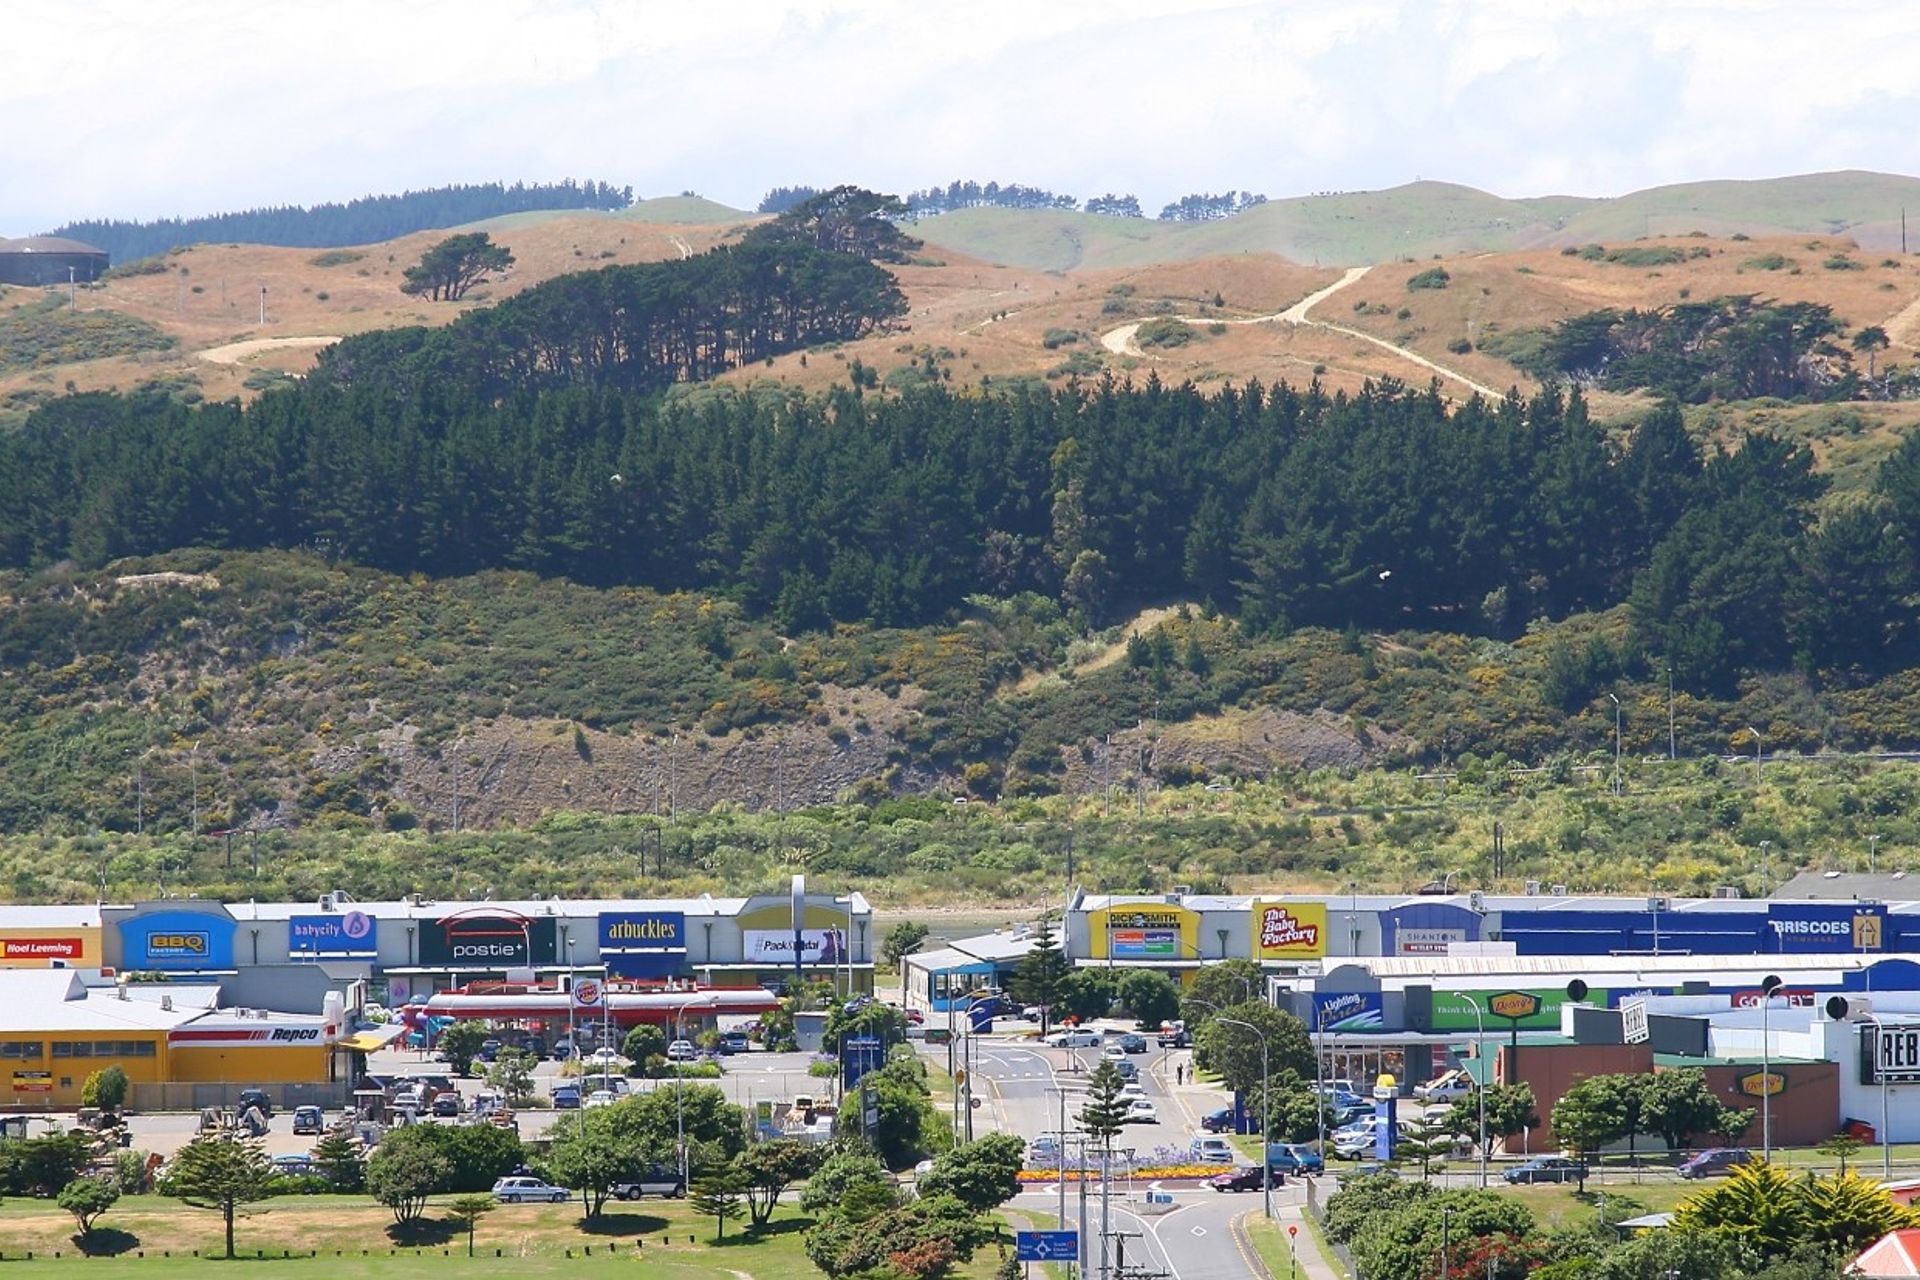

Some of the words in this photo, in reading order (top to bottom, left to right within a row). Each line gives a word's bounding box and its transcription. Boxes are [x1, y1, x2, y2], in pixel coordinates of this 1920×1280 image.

[1110, 914, 1134, 923] DICK
[1143, 914, 1177, 923] SMITH
[1265, 910, 1286, 920] The
[294, 922, 340, 938] babycity
[608, 919, 676, 938] arbuckles
[1264, 919, 1296, 933] Baby
[1774, 920, 1850, 934] BRISCOES
[152, 935, 203, 952] BBQ
[1262, 929, 1315, 946] Factory
[1407, 933, 1457, 941] SHANTON
[6, 943, 30, 953] Noel
[31, 942, 73, 955] Leeming
[1324, 993, 1361, 1011] Lighting
[271, 1027, 319, 1043] Repco
